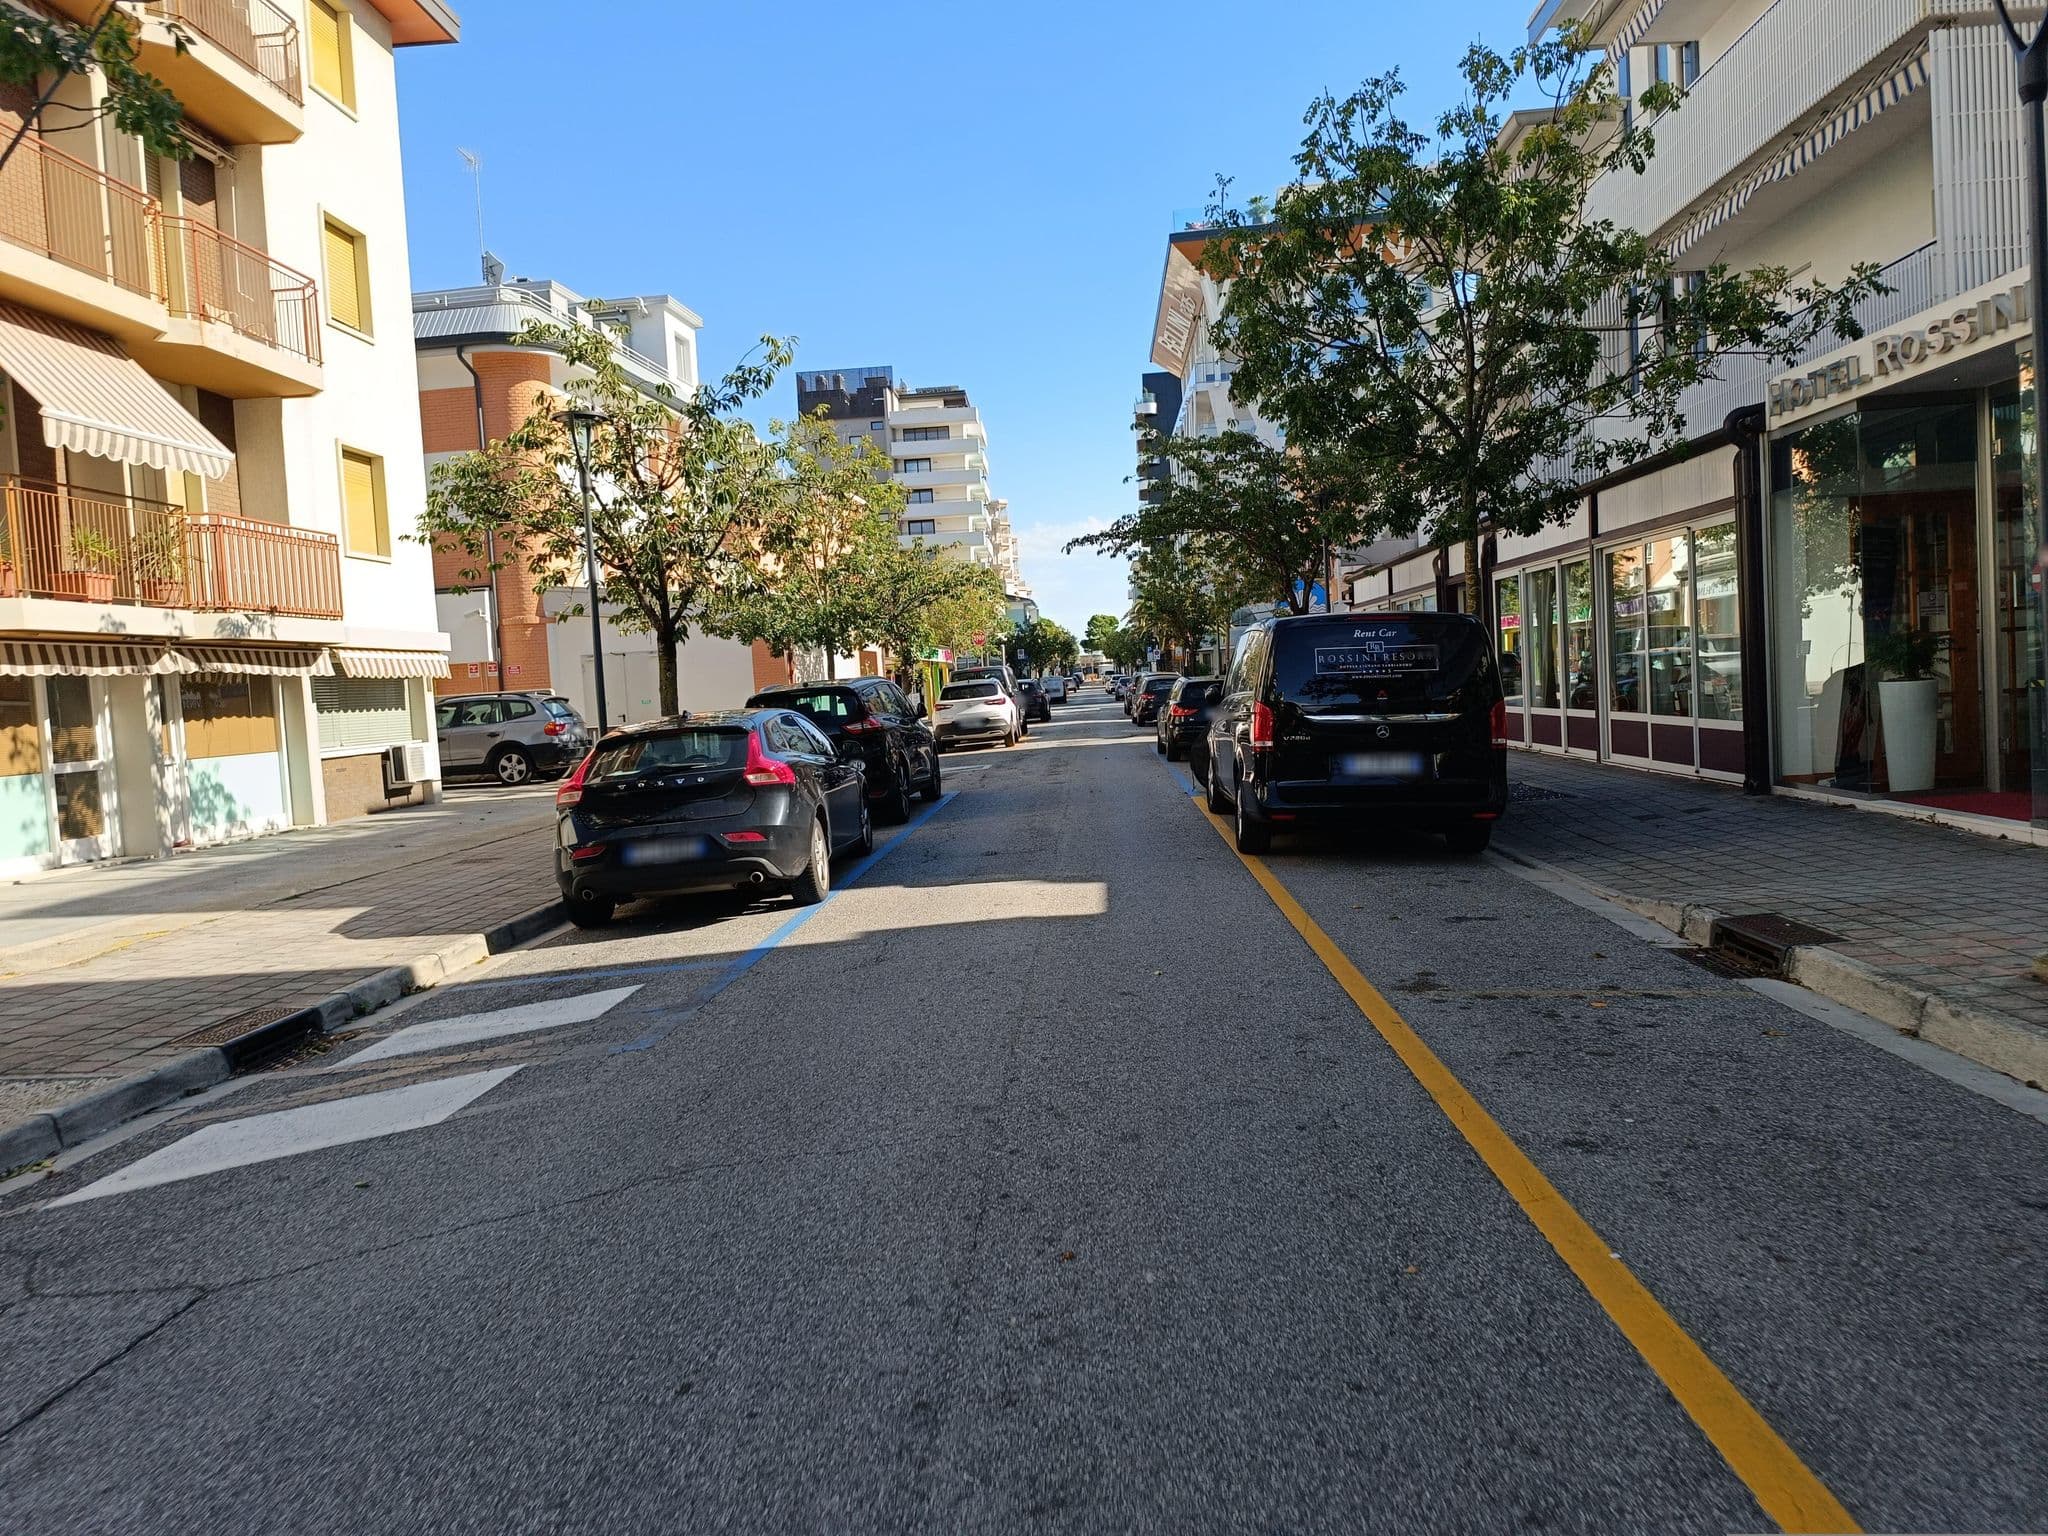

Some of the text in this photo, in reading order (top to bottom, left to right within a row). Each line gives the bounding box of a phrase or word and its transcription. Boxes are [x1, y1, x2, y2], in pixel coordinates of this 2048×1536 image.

[1769, 355, 1872, 416] HOTEL
[1353, 628, 1397, 638] Rent Car
[1318, 652, 1378, 664] ROSSINI
[617, 777, 705, 790] VOLVO
